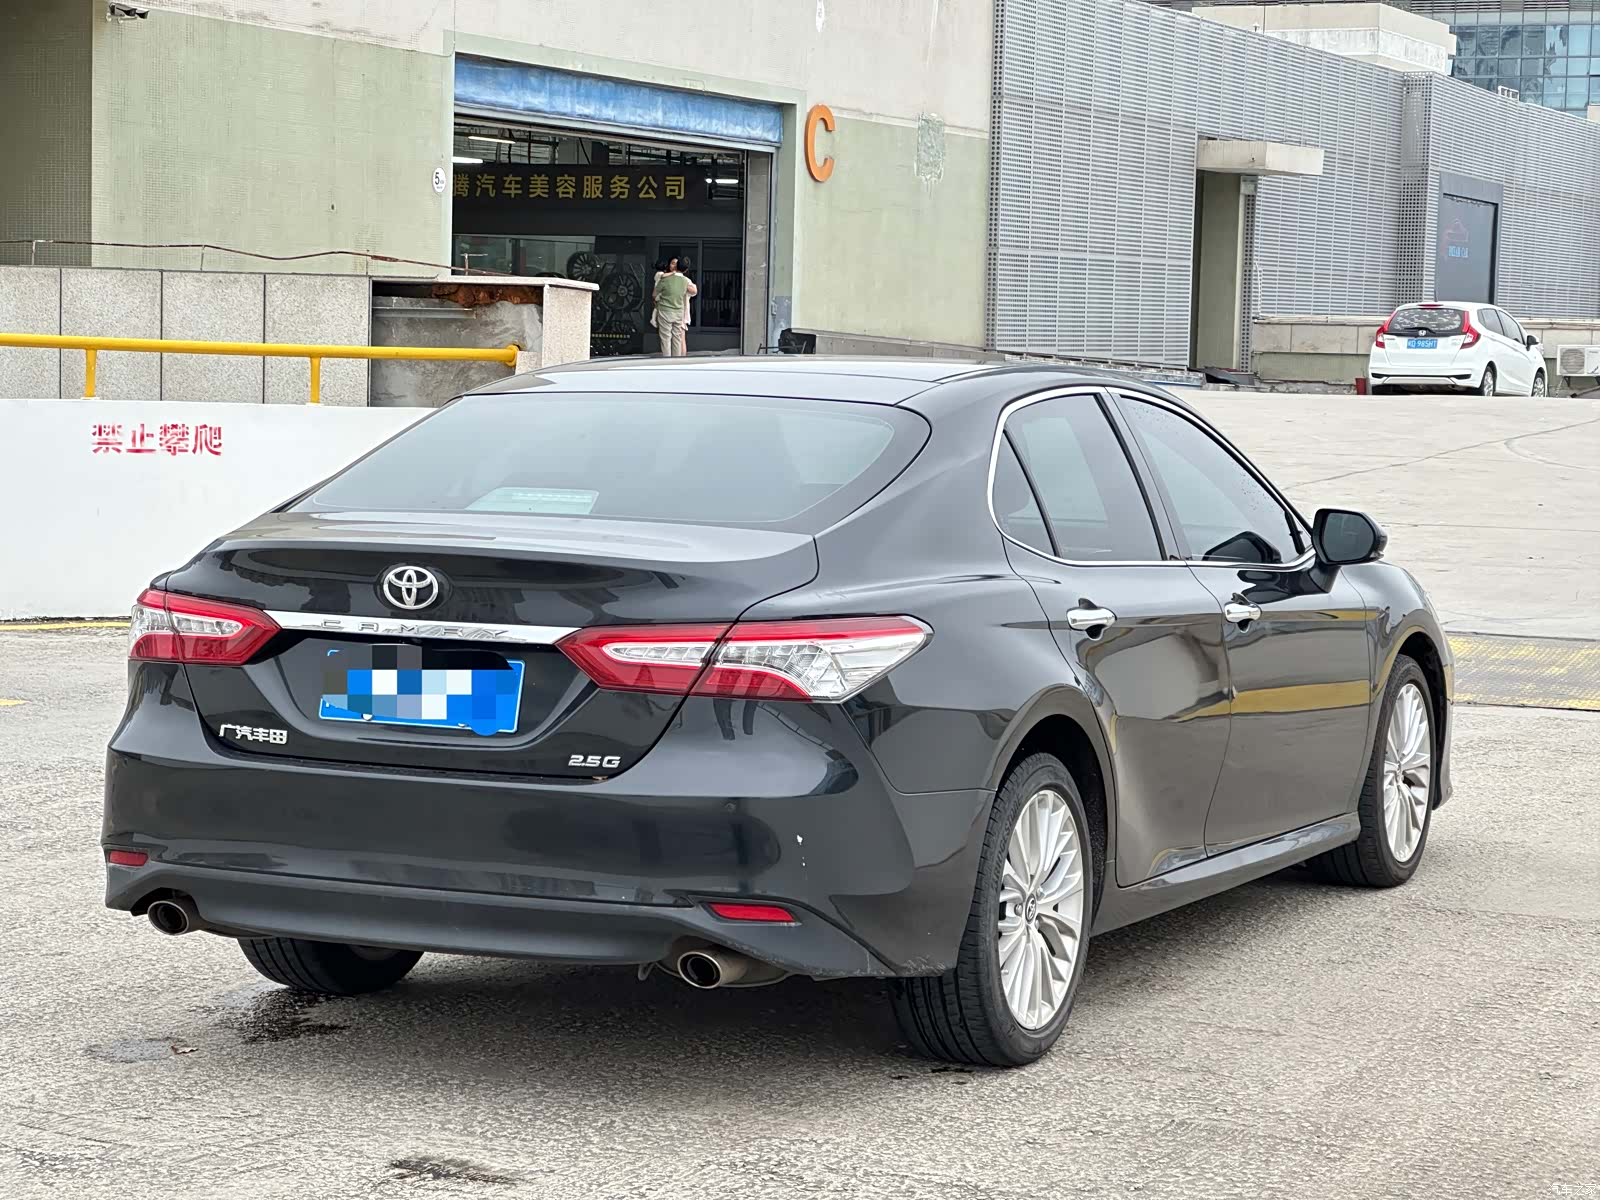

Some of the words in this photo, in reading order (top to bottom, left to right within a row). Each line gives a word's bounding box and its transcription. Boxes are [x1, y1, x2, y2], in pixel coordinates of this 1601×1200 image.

[804, 104, 836, 183] C
[453, 173, 686, 200] 腾汽车美容服务公司
[92, 423, 222, 456] 禁止攀爬
[321, 619, 509, 638] CAMRY
[219, 724, 288, 745] 广汽丰田
